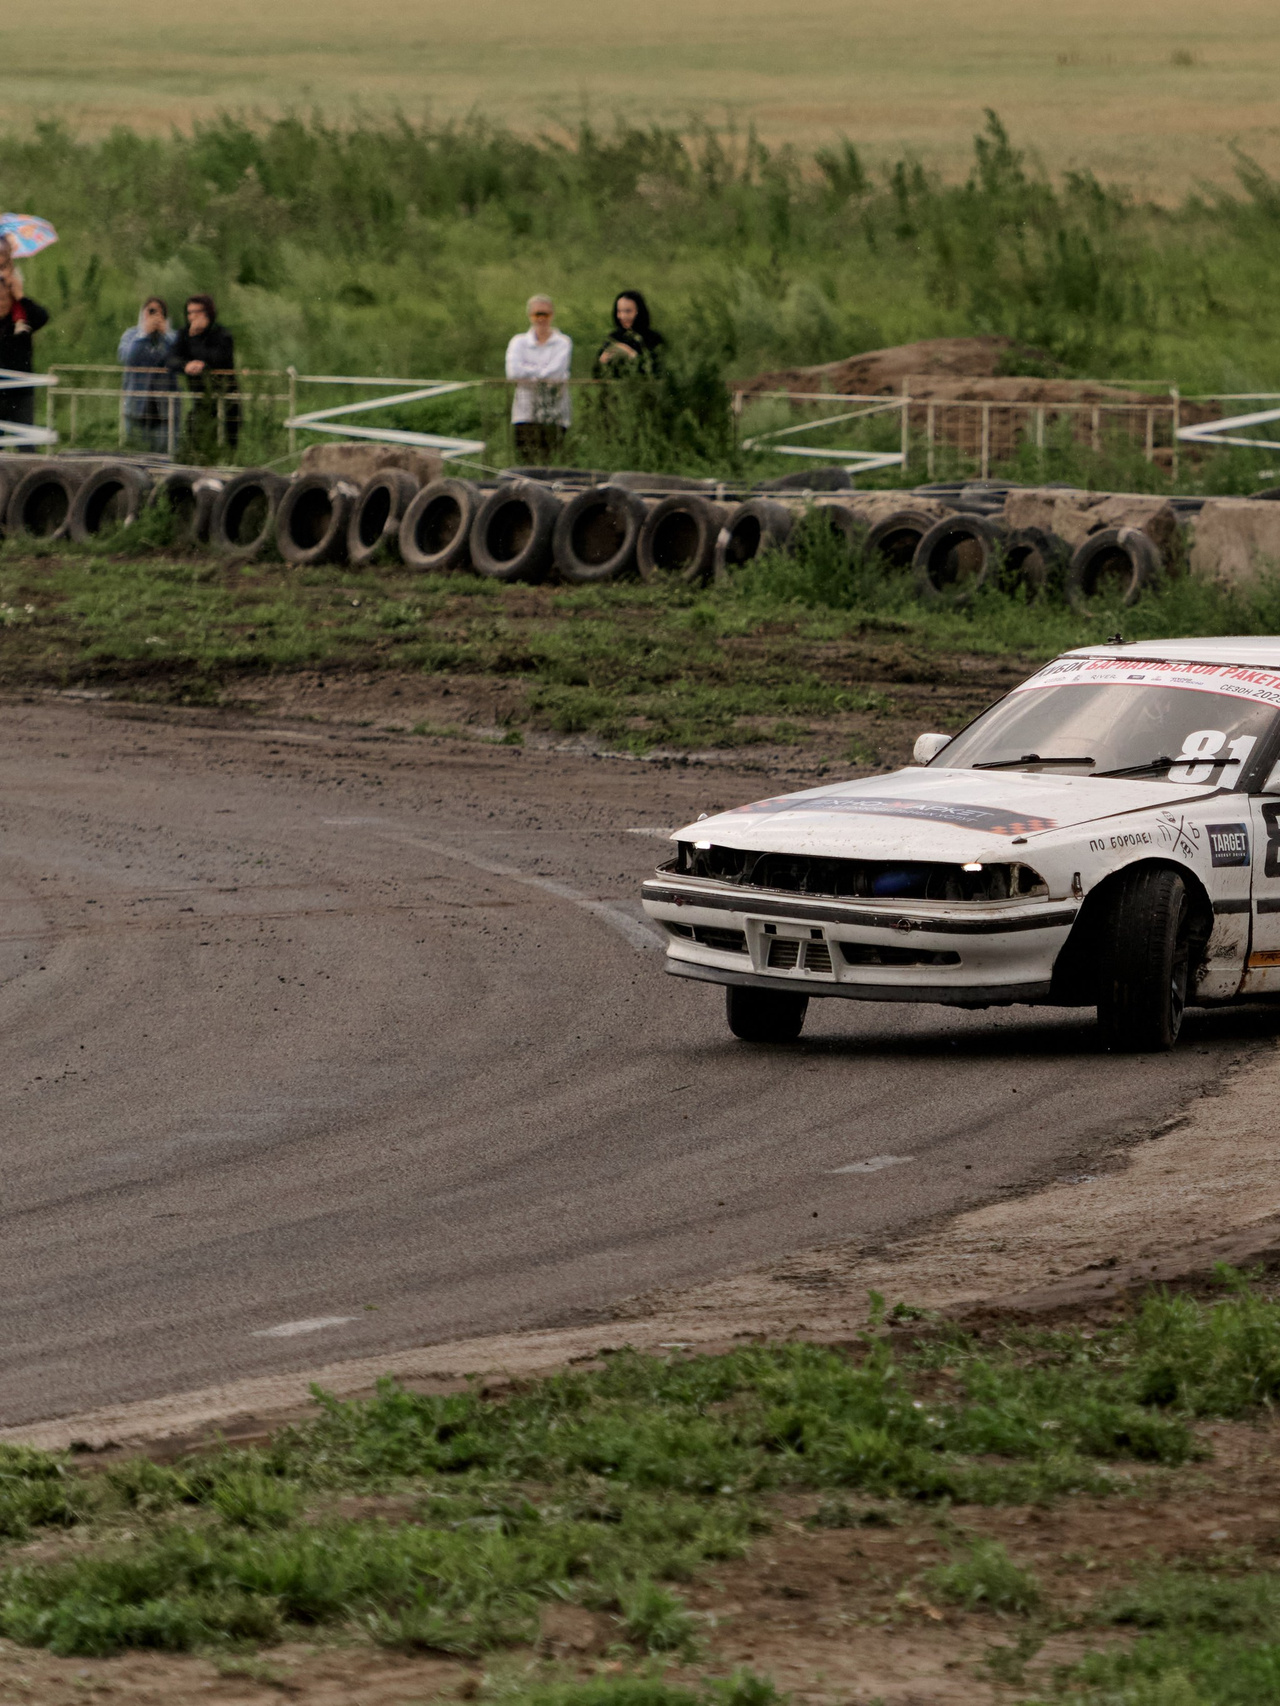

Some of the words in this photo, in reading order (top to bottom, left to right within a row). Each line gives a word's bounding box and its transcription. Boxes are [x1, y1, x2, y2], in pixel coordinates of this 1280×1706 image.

[1220, 684, 1254, 695] СЕЗОН
[1167, 730, 1257, 790] 81
[1089, 838, 1105, 852] ПО
[1110, 832, 1153, 849] БОРОДЕ!
[1210, 832, 1246, 852] TARGET
